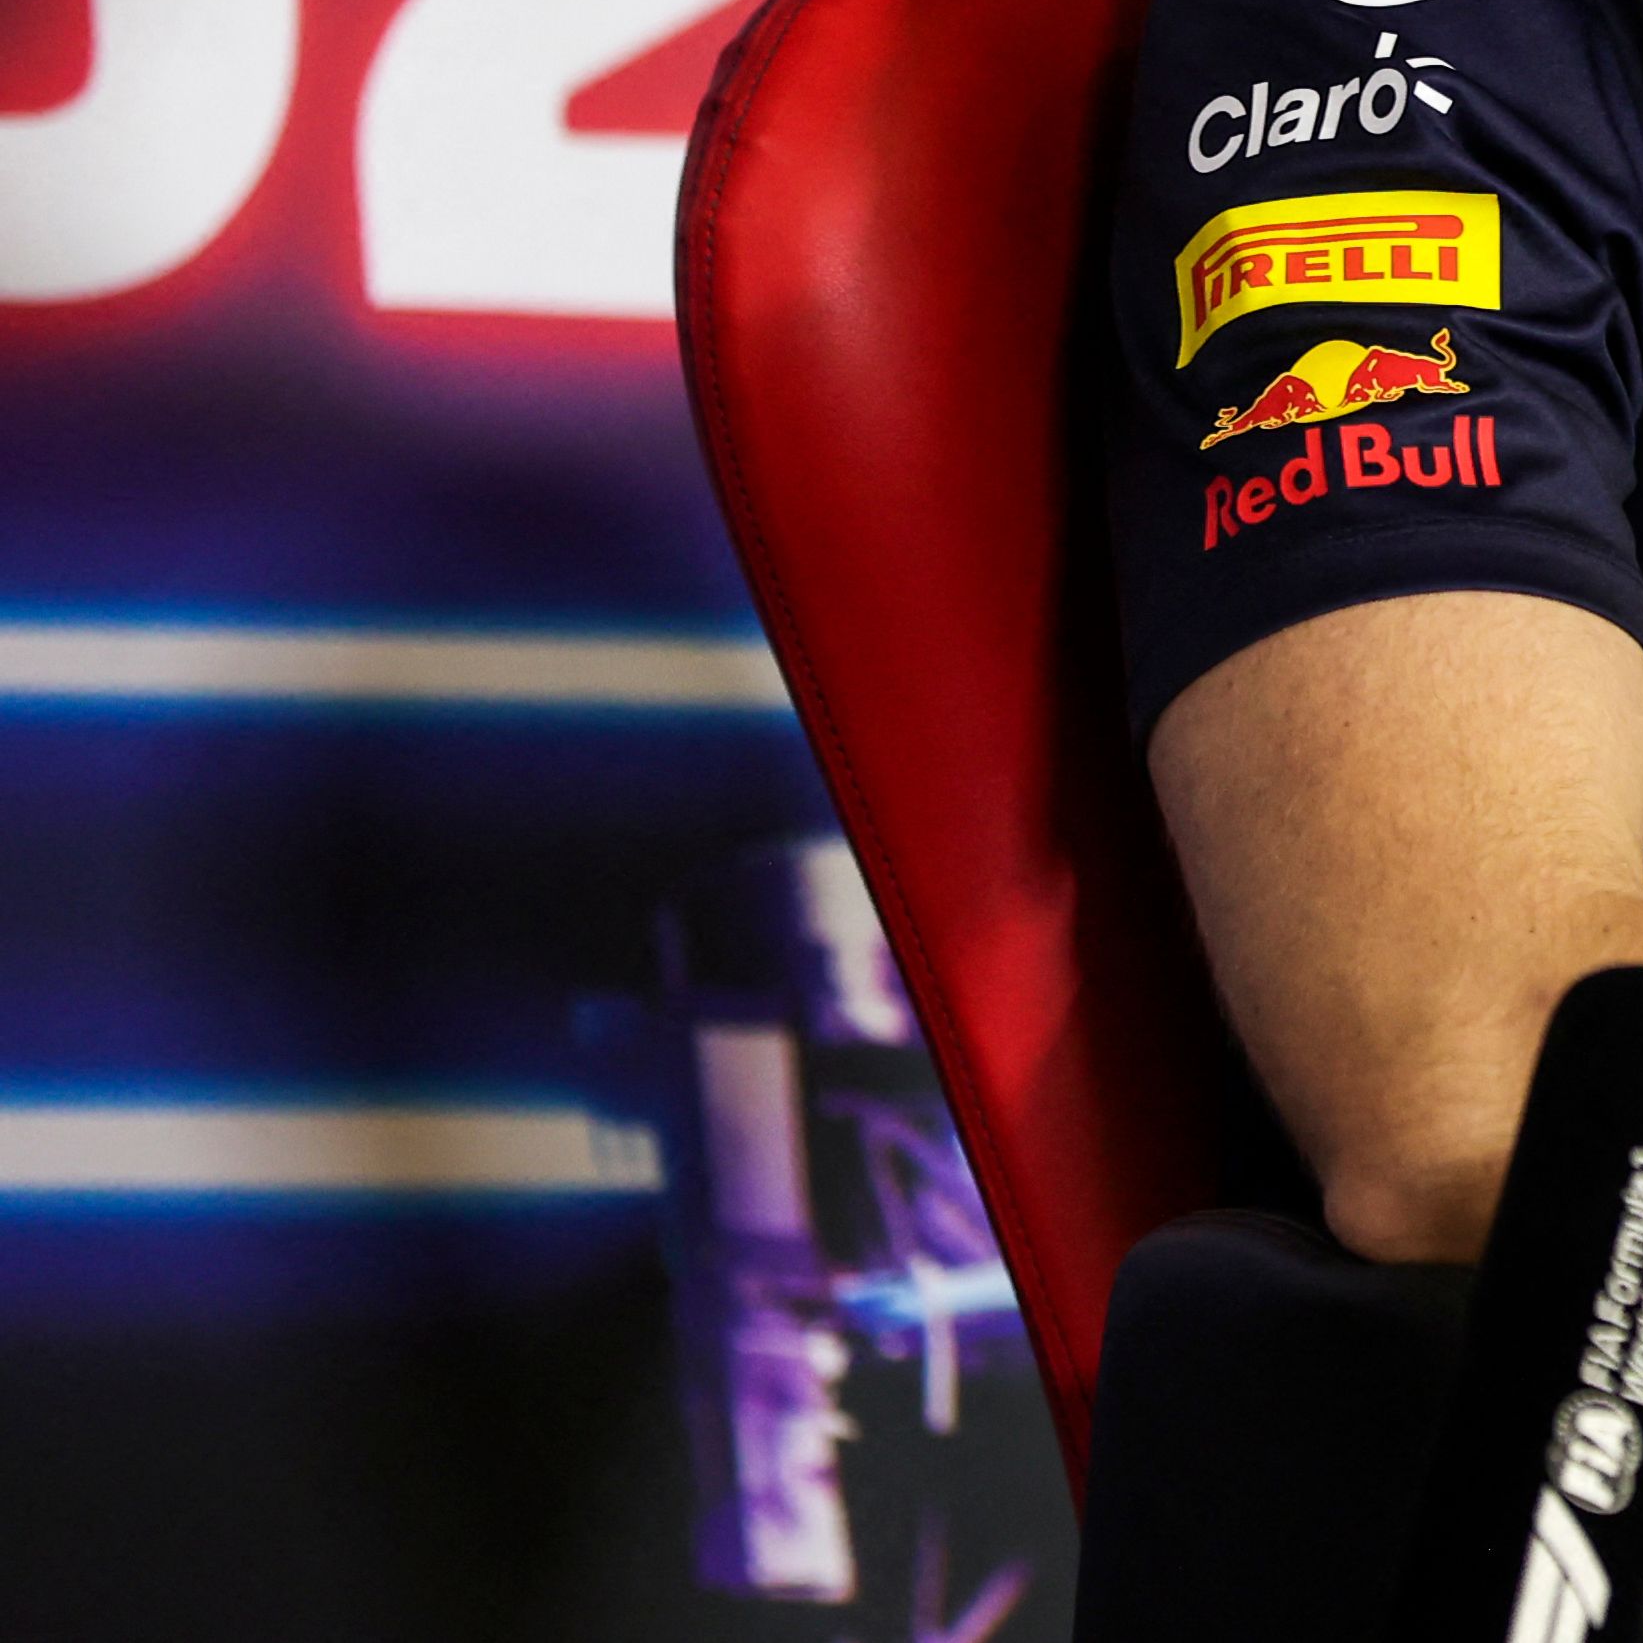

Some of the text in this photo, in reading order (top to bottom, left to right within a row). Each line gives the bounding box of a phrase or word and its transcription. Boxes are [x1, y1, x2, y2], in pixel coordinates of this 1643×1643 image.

[1188, 67, 1407, 174] Claro
[1192, 214, 1465, 332] PIRELLI
[1203, 415, 1502, 551] Red Bull
